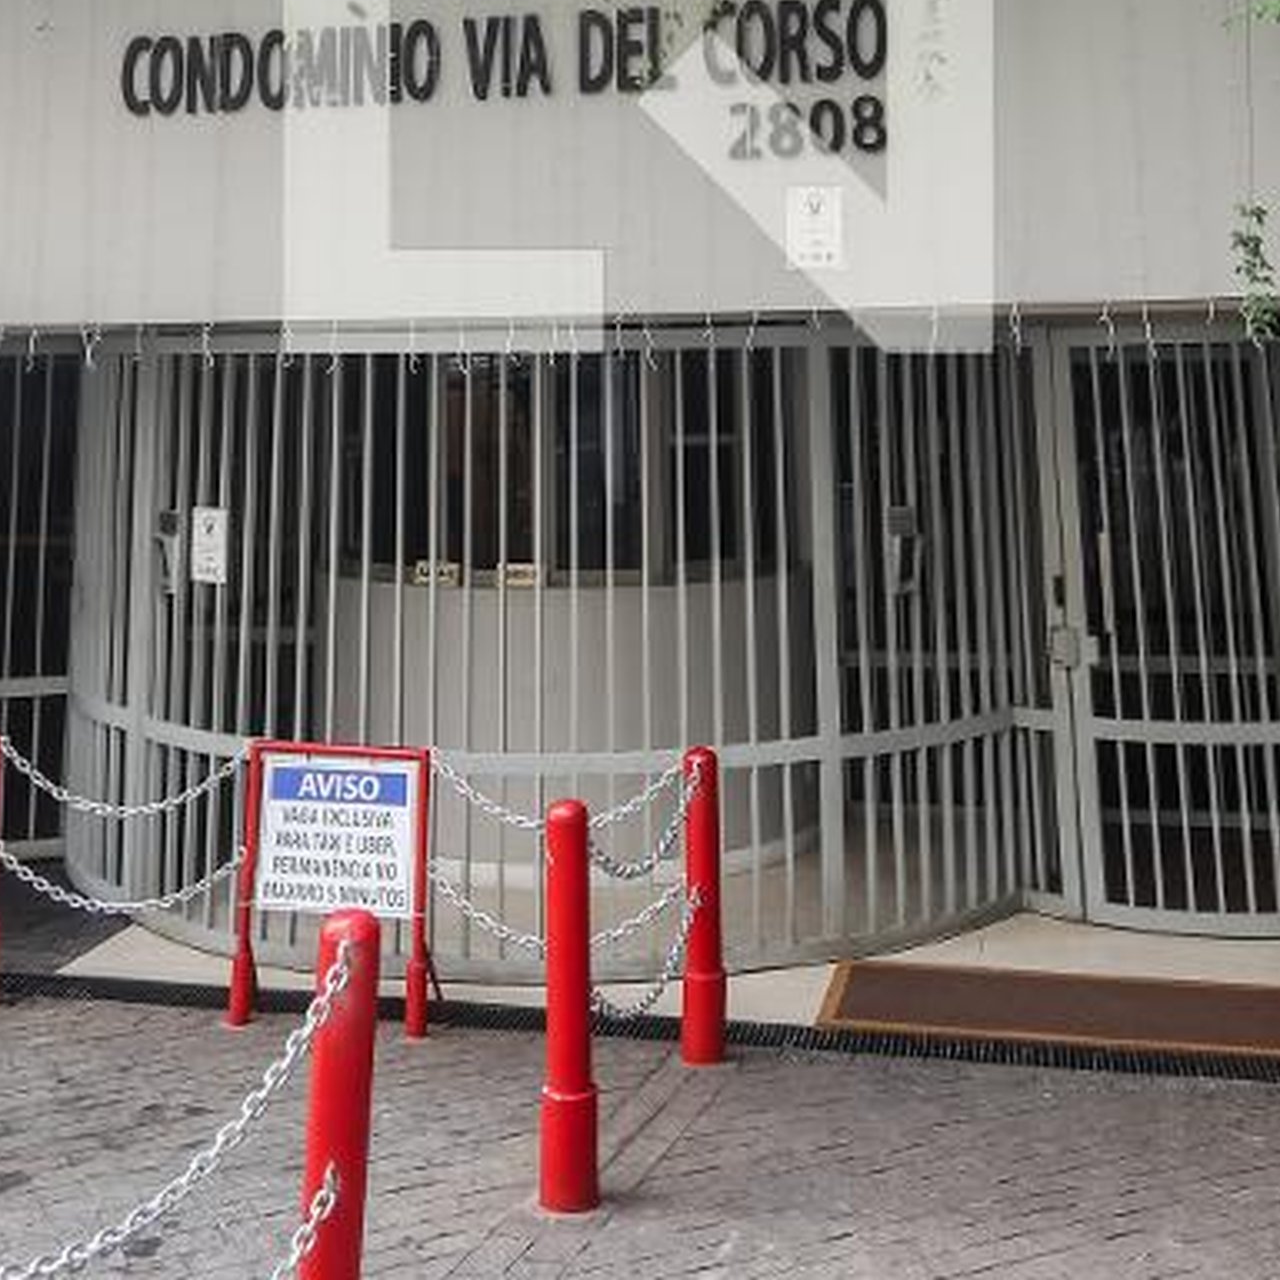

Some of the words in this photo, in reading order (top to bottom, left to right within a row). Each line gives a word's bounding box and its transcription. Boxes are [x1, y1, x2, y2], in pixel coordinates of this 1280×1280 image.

[463, 14, 553, 101] VIA
[578, 6, 678, 94] DEL
[728, 94, 888, 160] 2808
[297, 773, 381, 801] AVISO
[282, 806, 318, 825] VAGA
[322, 808, 395, 829] EXCLUSIVA
[275, 830, 310, 850] PARA
[345, 833, 355, 854] E
[375, 862, 399, 882] NO
